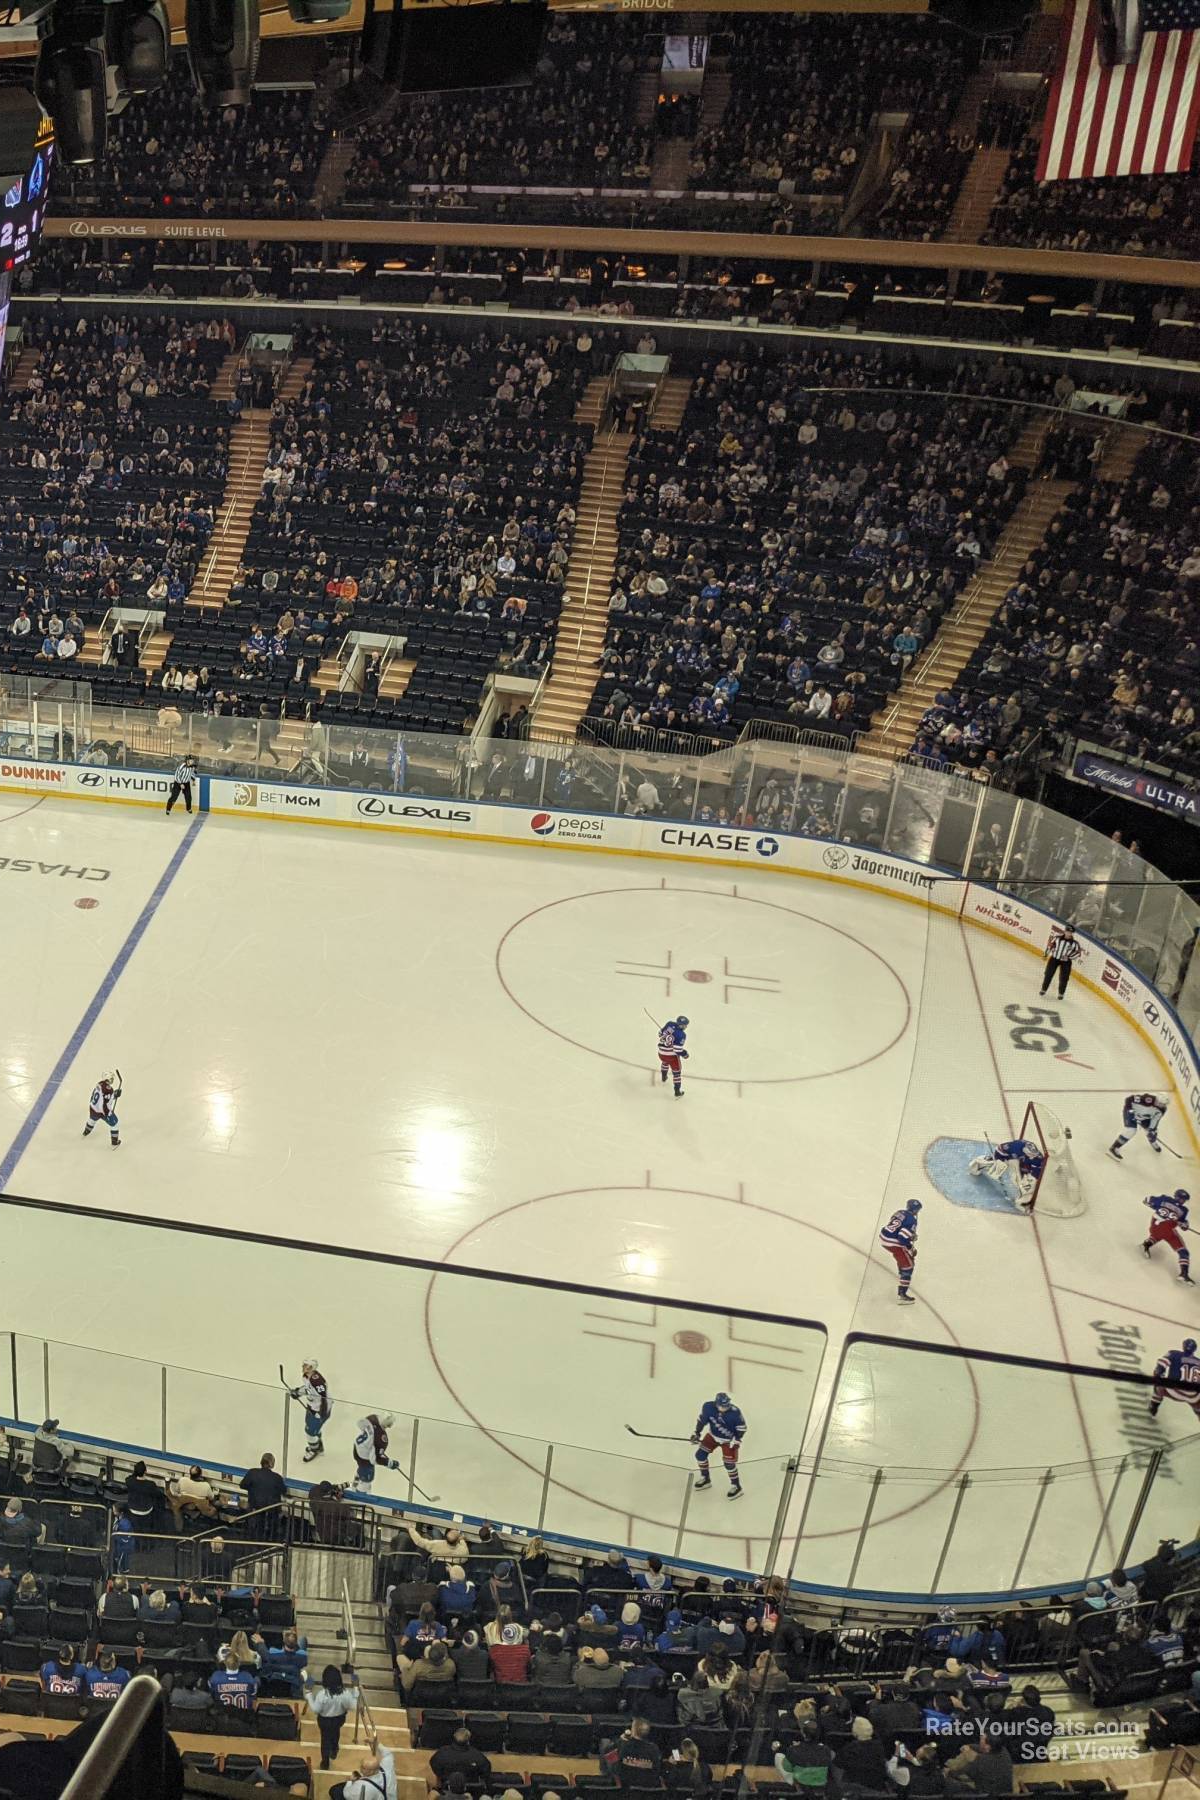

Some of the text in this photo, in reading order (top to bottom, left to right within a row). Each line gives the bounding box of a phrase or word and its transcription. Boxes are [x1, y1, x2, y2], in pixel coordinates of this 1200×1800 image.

[0, 222, 13, 247] 2
[90, 225, 228, 237] LEXUS SUITE LEVEL
[1, 764, 66, 783] DUNKIN'
[1084, 765, 1197, 813] Michelob ULTRA
[260, 792, 320, 807] BETMGM
[389, 804, 471, 822] LEXUS
[558, 817, 604, 833] pepsi
[577, 832, 602, 840] SUGAR
[661, 829, 750, 852] CHASE
[1003, 1003, 1071, 1053] 5G
[1160, 1022, 1192, 1088] HYUNDAI
